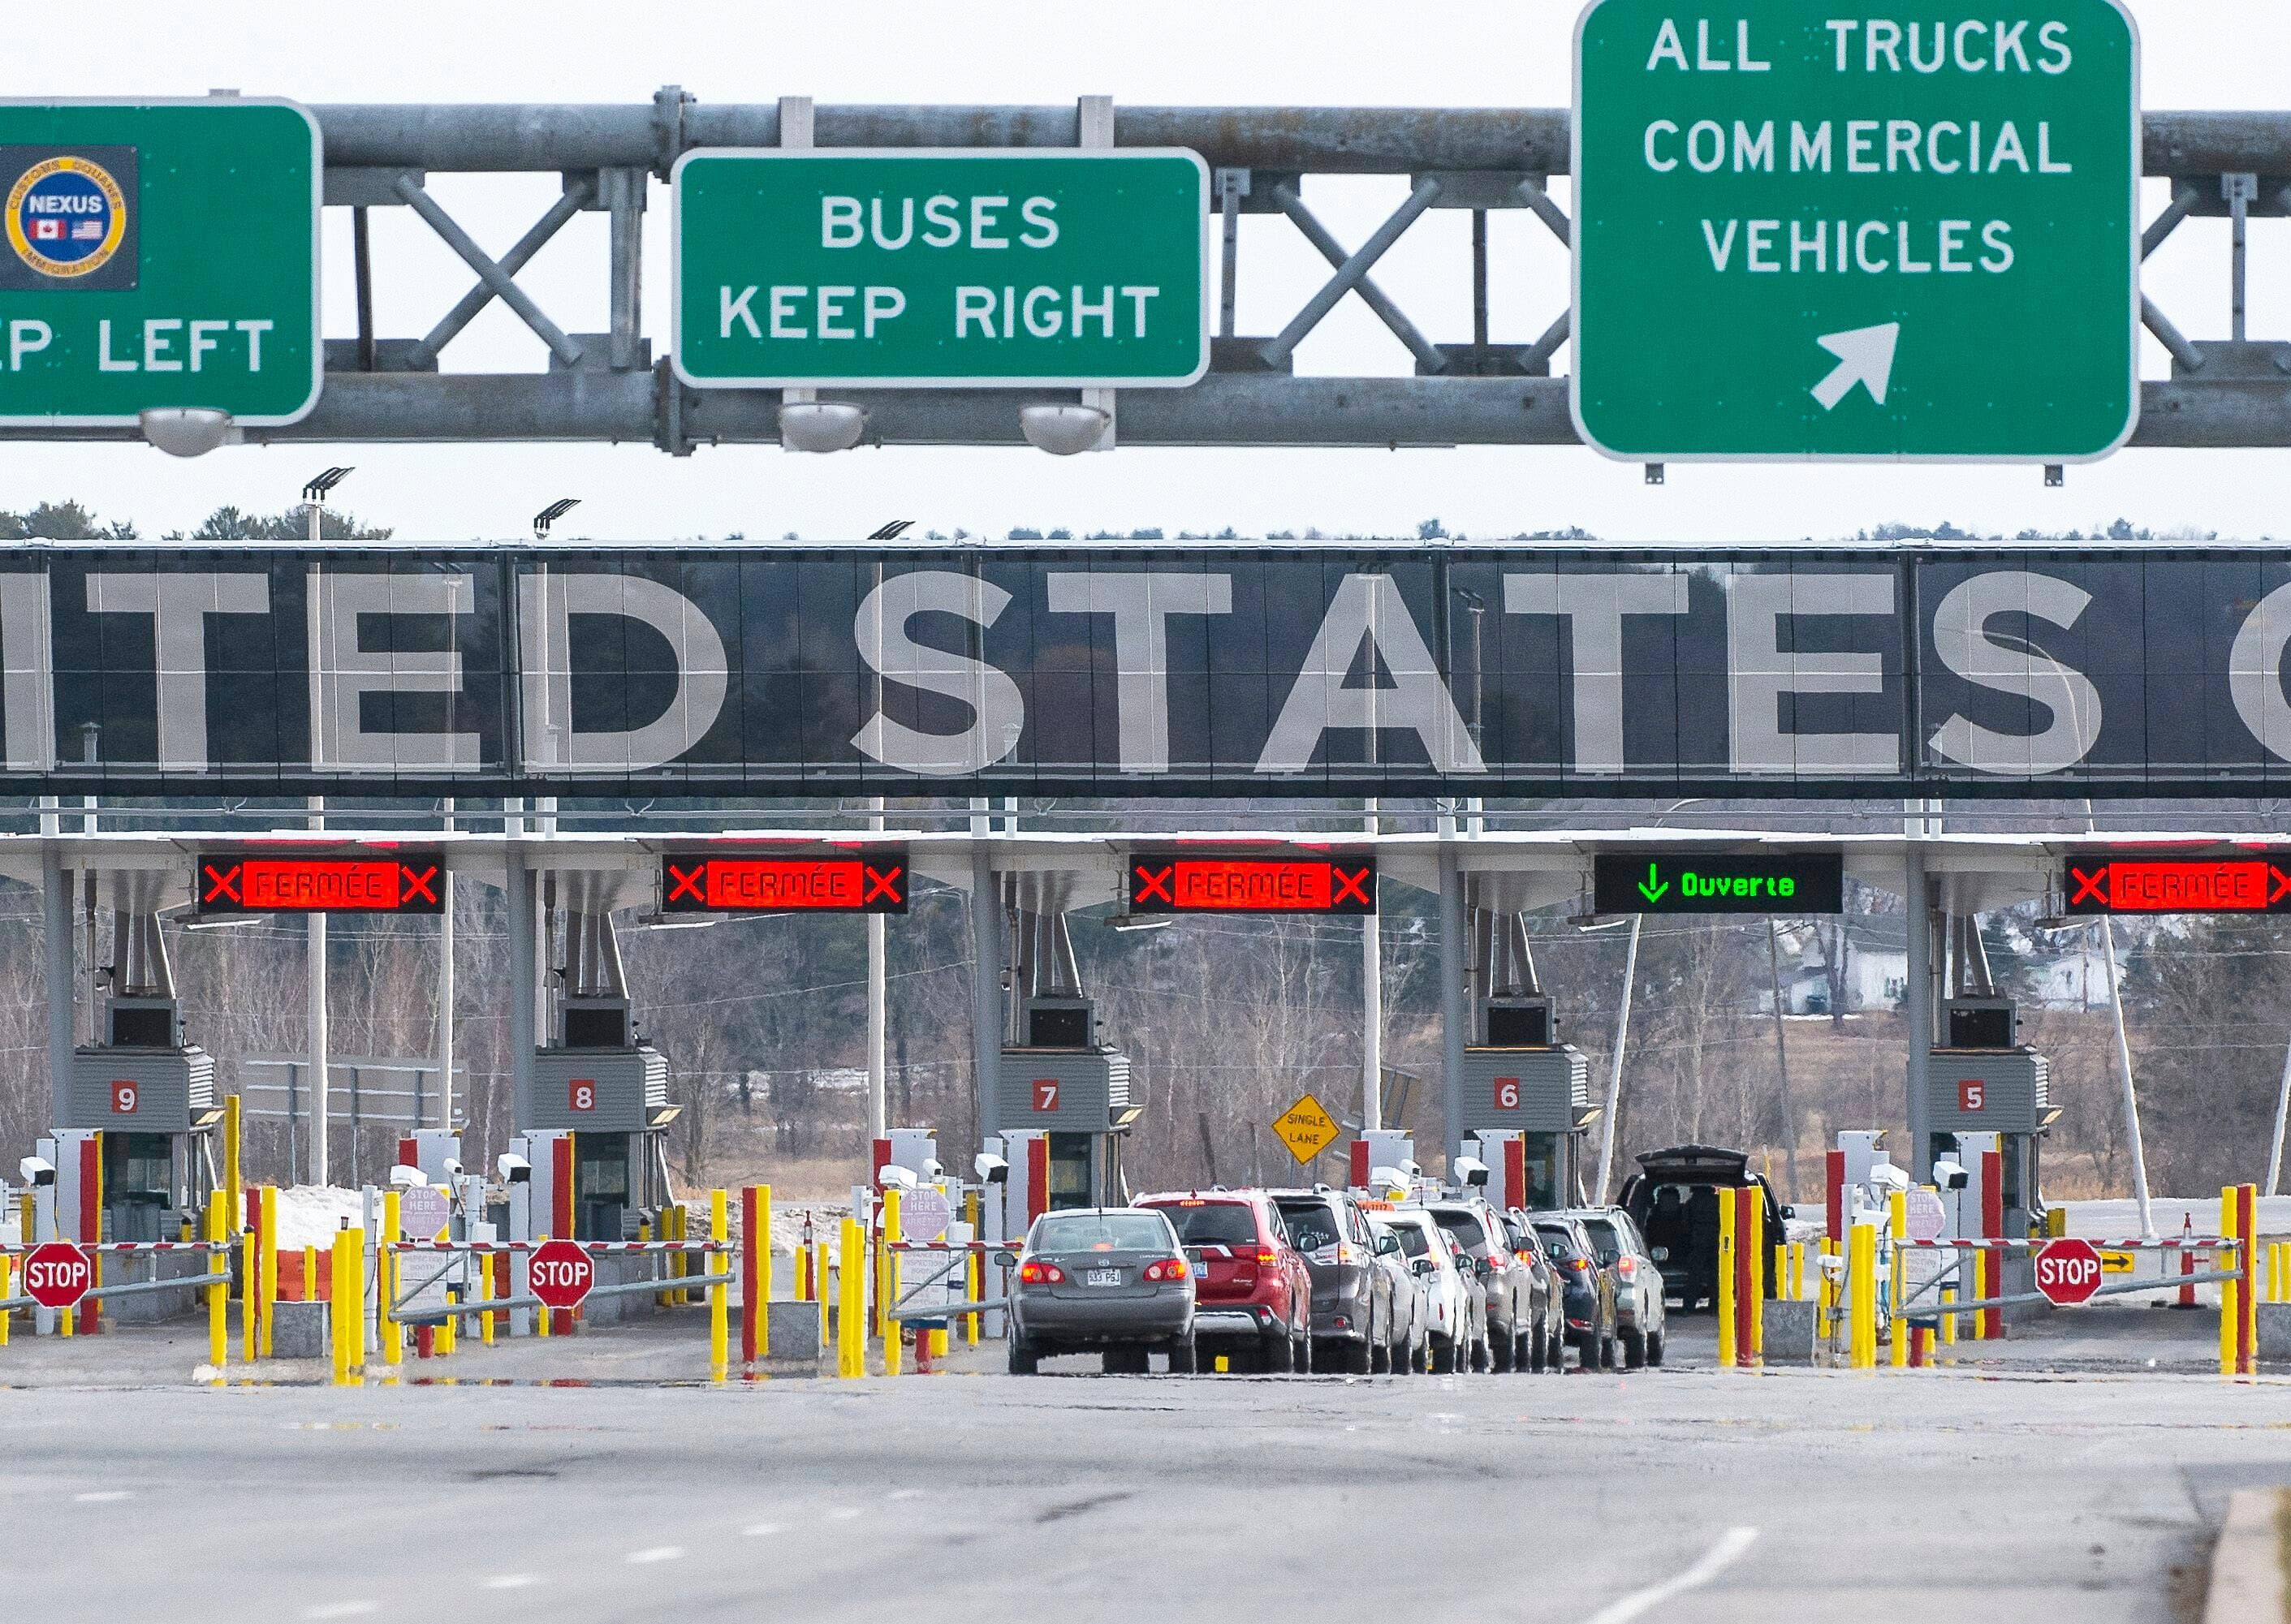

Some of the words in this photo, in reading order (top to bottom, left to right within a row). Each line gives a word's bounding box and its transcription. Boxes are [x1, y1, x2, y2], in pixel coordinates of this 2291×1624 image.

[1648, 19, 1771, 71] ALL
[1827, 19, 2073, 74] TRUCKS
[1644, 119, 2073, 173] COMMERCIAL
[29, 195, 103, 213] NEXUS
[822, 195, 1059, 250] BUSES
[1702, 220, 2015, 273] VEHICLES
[720, 286, 906, 338] KEEP
[956, 286, 1160, 338] RIGHT
[0, 320, 53, 372] P
[99, 319, 274, 373] LEFT
[850, 570, 2103, 775] STATES
[256, 864, 383, 898] FERMÉE
[720, 864, 846, 898] FERMÉE
[1188, 864, 1313, 899] FERMÉE
[1681, 872, 1795, 897] Ouverte
[2122, 865, 2249, 899] FERMÉE
[118, 1088, 136, 1113] 9
[576, 1086, 593, 1109] 8
[1039, 1086, 1057, 1110] 7
[1499, 1083, 1518, 1108] 6
[1965, 1087, 1983, 1109] 5
[1287, 1114, 1326, 1127] SINGLE
[1288, 1132, 1320, 1145] LANE
[409, 1189, 437, 1200] STOP
[409, 1201, 437, 1211] HERE
[911, 1191, 937, 1201] STOP
[911, 1201, 937, 1212] HERE
[1910, 1194, 1936, 1203] STOP
[1909, 1204, 1935, 1214] HERE
[28, 1262, 86, 1288] STOP
[532, 1260, 590, 1287] STOP
[2039, 1258, 2099, 1285] STOP
